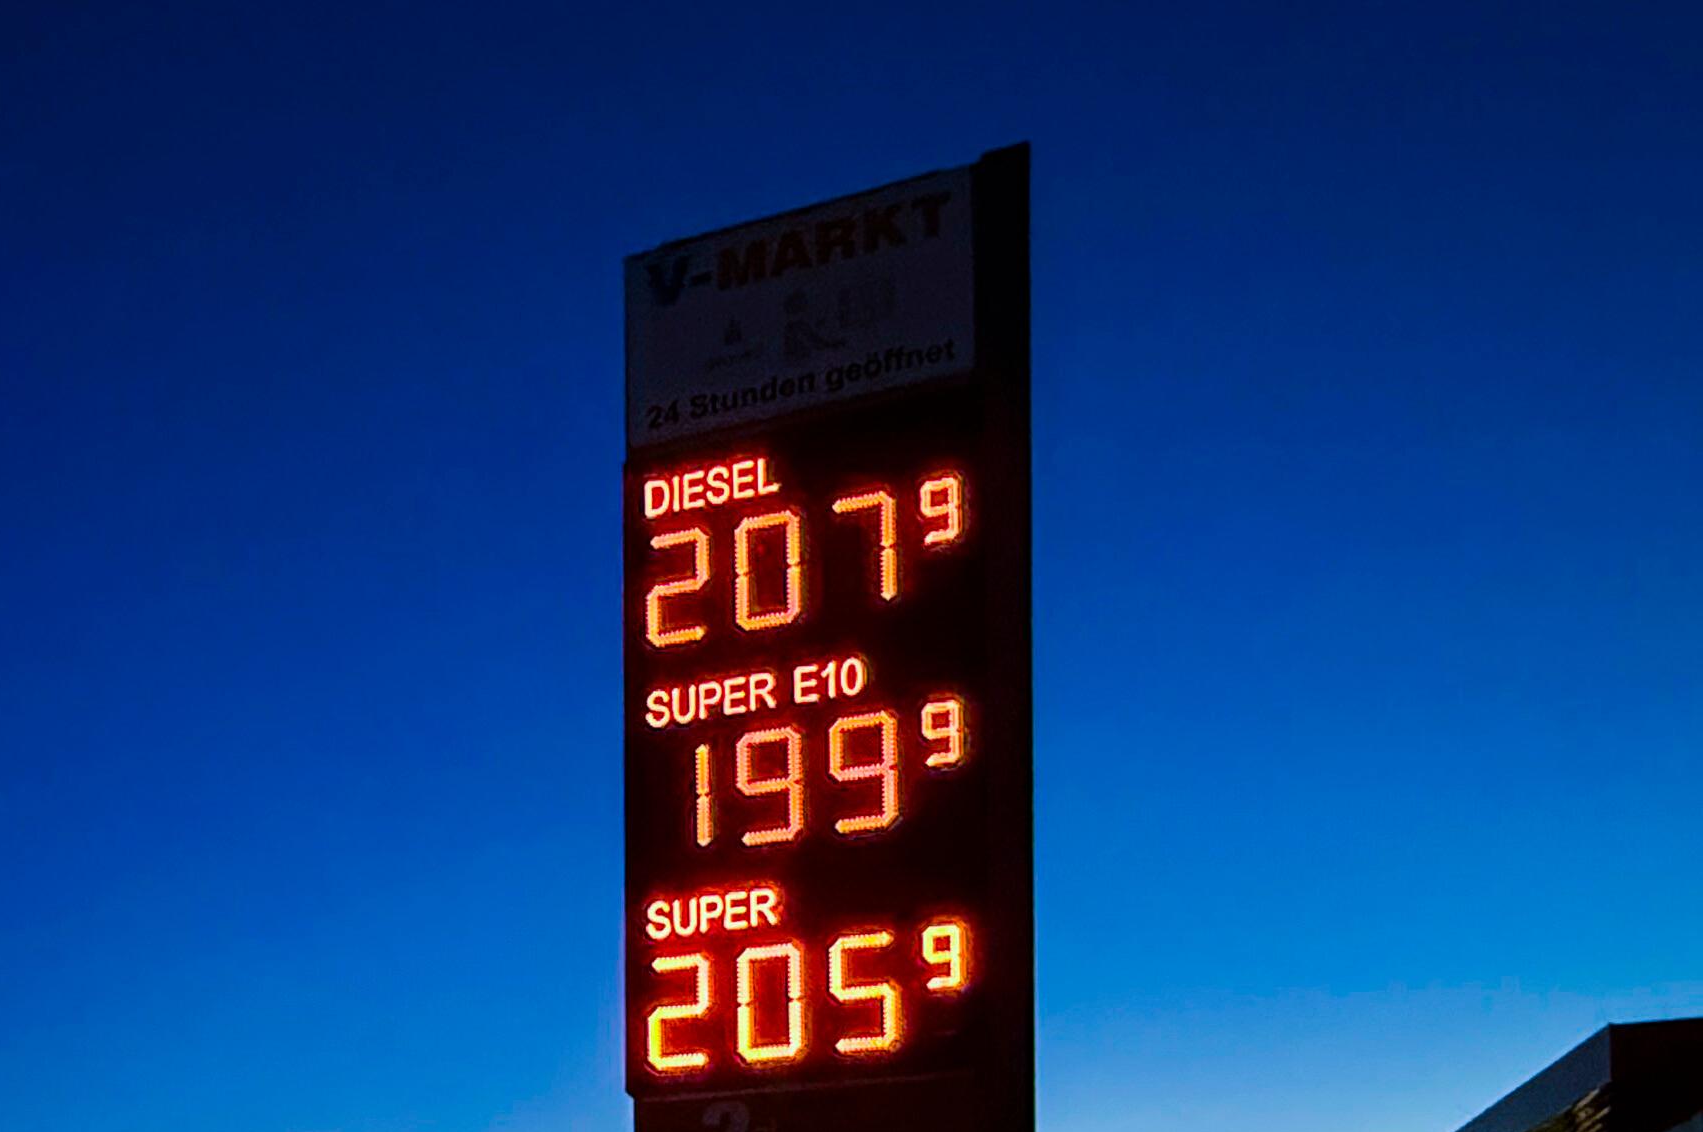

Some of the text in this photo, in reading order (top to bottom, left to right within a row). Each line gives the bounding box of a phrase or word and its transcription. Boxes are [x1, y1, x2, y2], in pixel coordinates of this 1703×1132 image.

[647, 193, 951, 305] V-MARKT
[647, 338, 956, 429] 24 Stunden geöffnet
[645, 459, 782, 520] DIESEL
[646, 657, 864, 729] SUPER E10
[647, 889, 778, 939] SUPER
